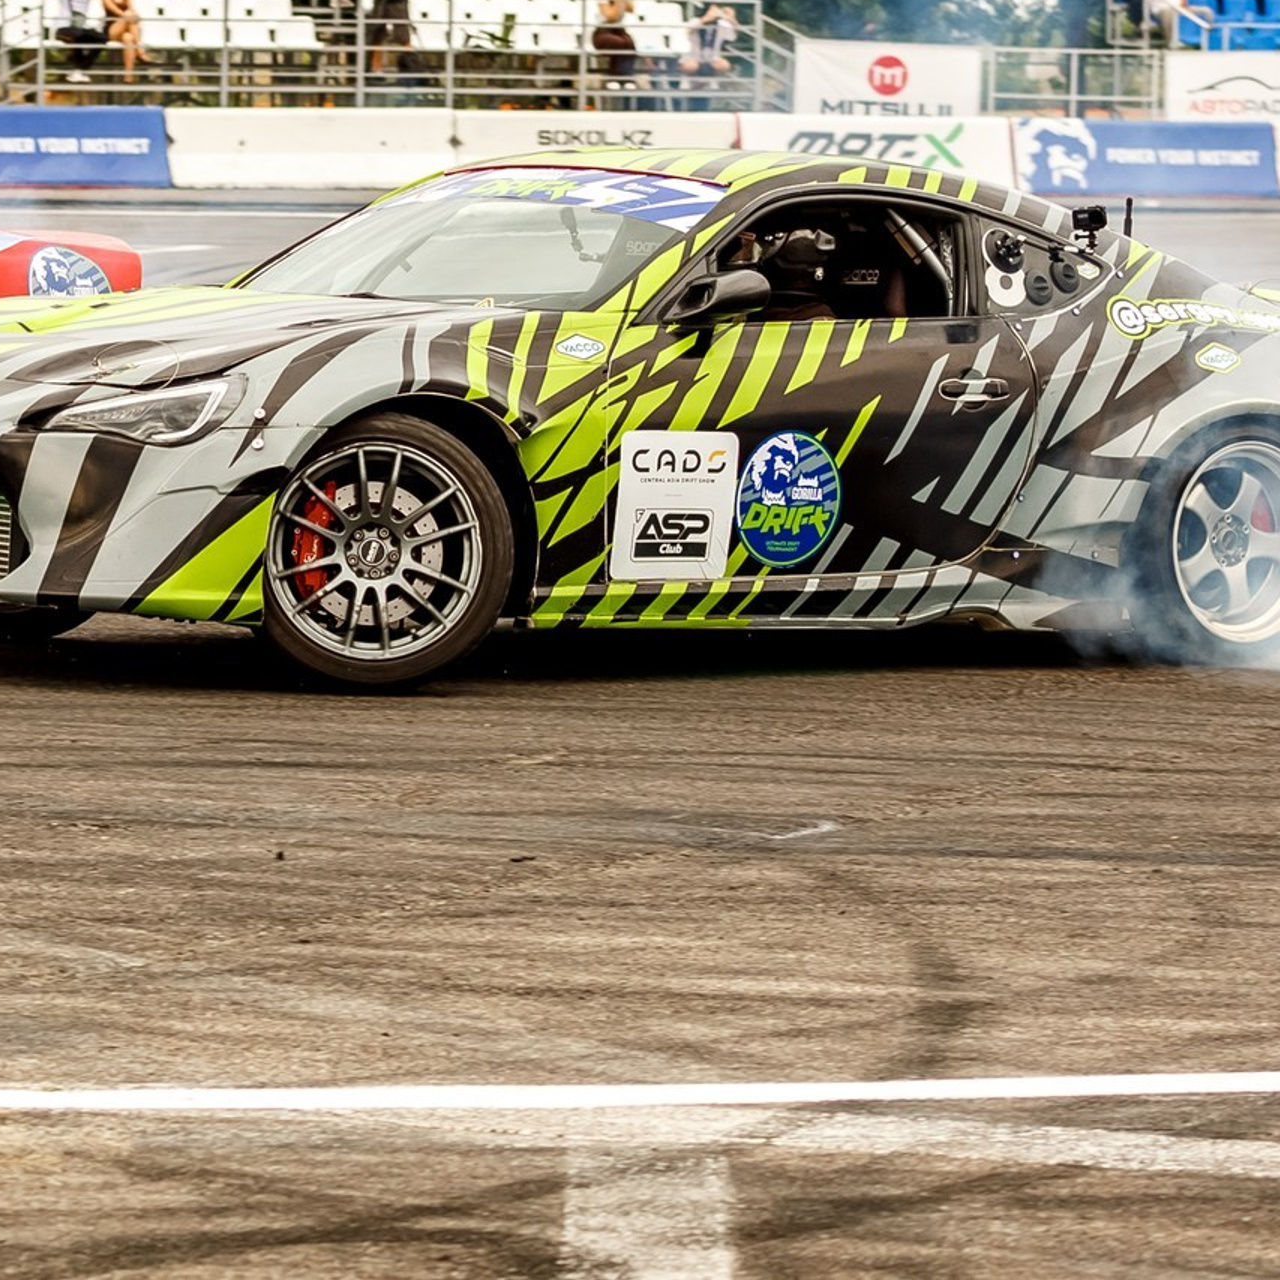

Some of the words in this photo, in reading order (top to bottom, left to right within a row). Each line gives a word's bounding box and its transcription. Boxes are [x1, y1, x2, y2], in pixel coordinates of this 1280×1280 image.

[561, 342, 601, 352] YACCO
[632, 448, 727, 473] CADS
[792, 487, 822, 500] GORILLA
[636, 513, 710, 540] ASP
[741, 502, 830, 537] DRIFT
[659, 543, 683, 554] Club
